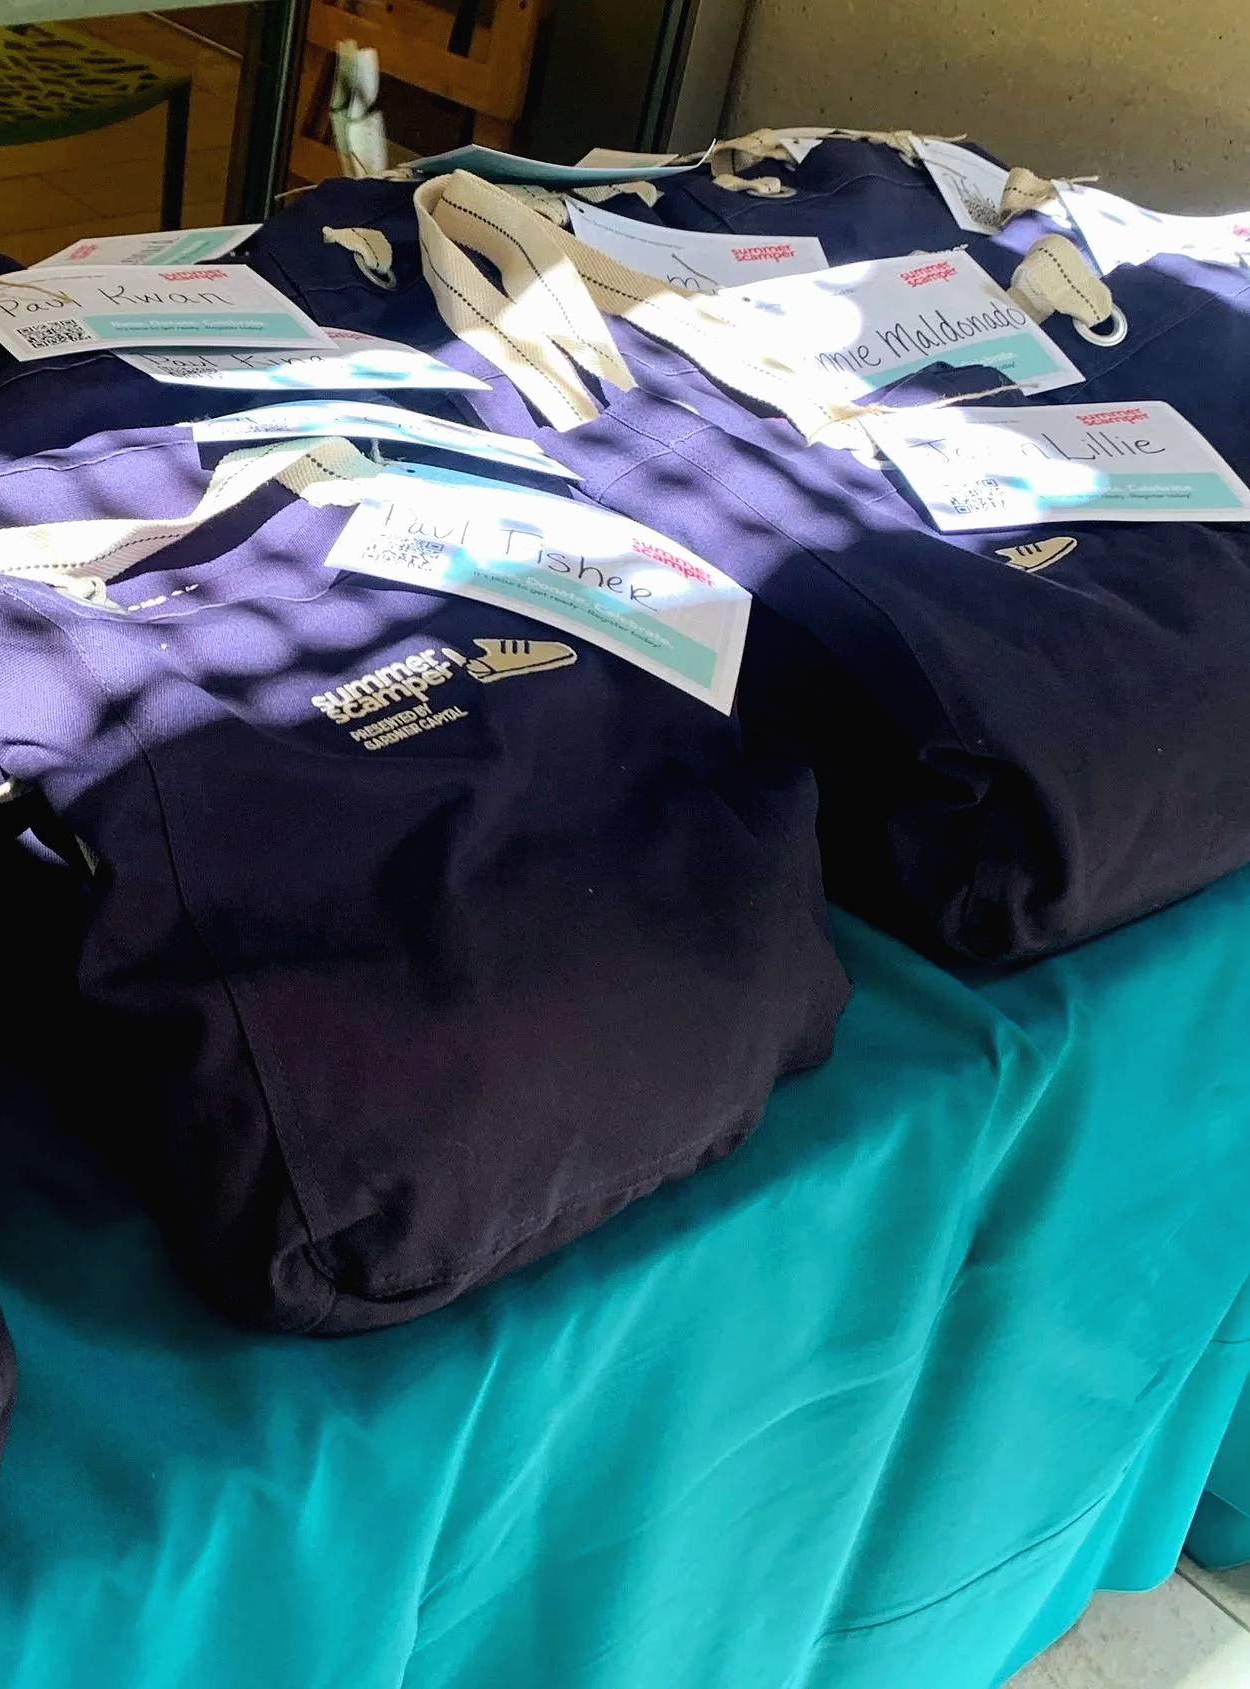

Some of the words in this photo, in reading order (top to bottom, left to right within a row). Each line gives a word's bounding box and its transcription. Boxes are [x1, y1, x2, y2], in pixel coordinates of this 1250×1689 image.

[731, 243, 793, 256] summer
[735, 249, 796, 262] scamper
[900, 261, 950, 280] summer
[906, 267, 958, 288] scamper
[99, 285, 235, 306] Kwan
[815, 344, 881, 373] nnie
[877, 302, 1026, 358] Maldonado
[1041, 431, 1166, 460] Lillie
[631, 537, 713, 578] summer
[632, 543, 715, 588] scamper
[311, 648, 439, 713] summer
[326, 660, 454, 725] scamper
[349, 709, 417, 742] PRESENTED
[417, 702, 433, 720] BY
[363, 723, 423, 751] GARDNER
[419, 705, 469, 731] CAPITAL
